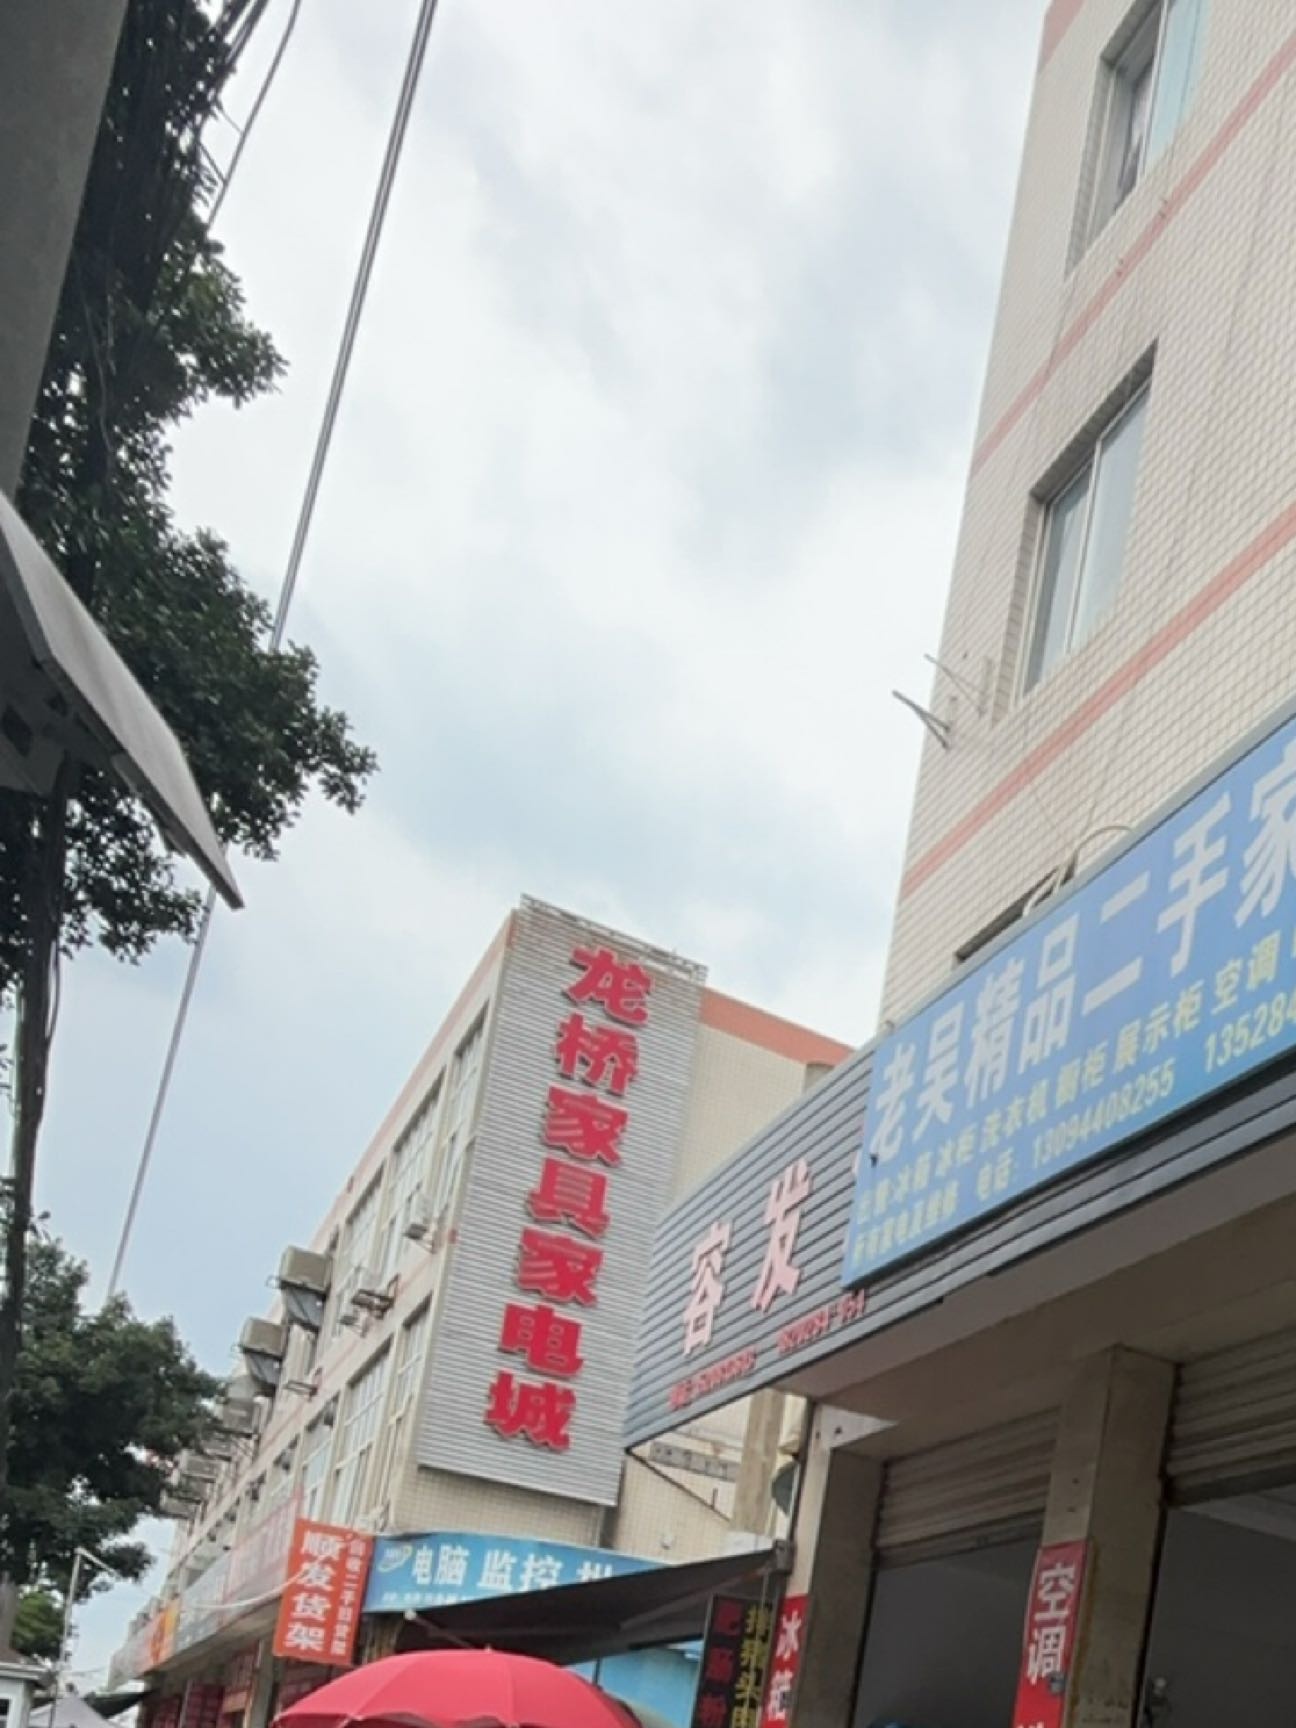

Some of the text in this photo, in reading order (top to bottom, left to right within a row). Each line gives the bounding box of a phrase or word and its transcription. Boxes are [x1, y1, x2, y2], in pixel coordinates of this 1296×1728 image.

[1113, 979, 1204, 1073] 展示柜
[1211, 930, 1282, 1015] 空调
[483, 945, 653, 1453] 龙桥家具家电城
[410, 1543, 470, 1587] 电脑
[477, 1549, 564, 1591] 监控
[1026, 1562, 1075, 1686] 空调
